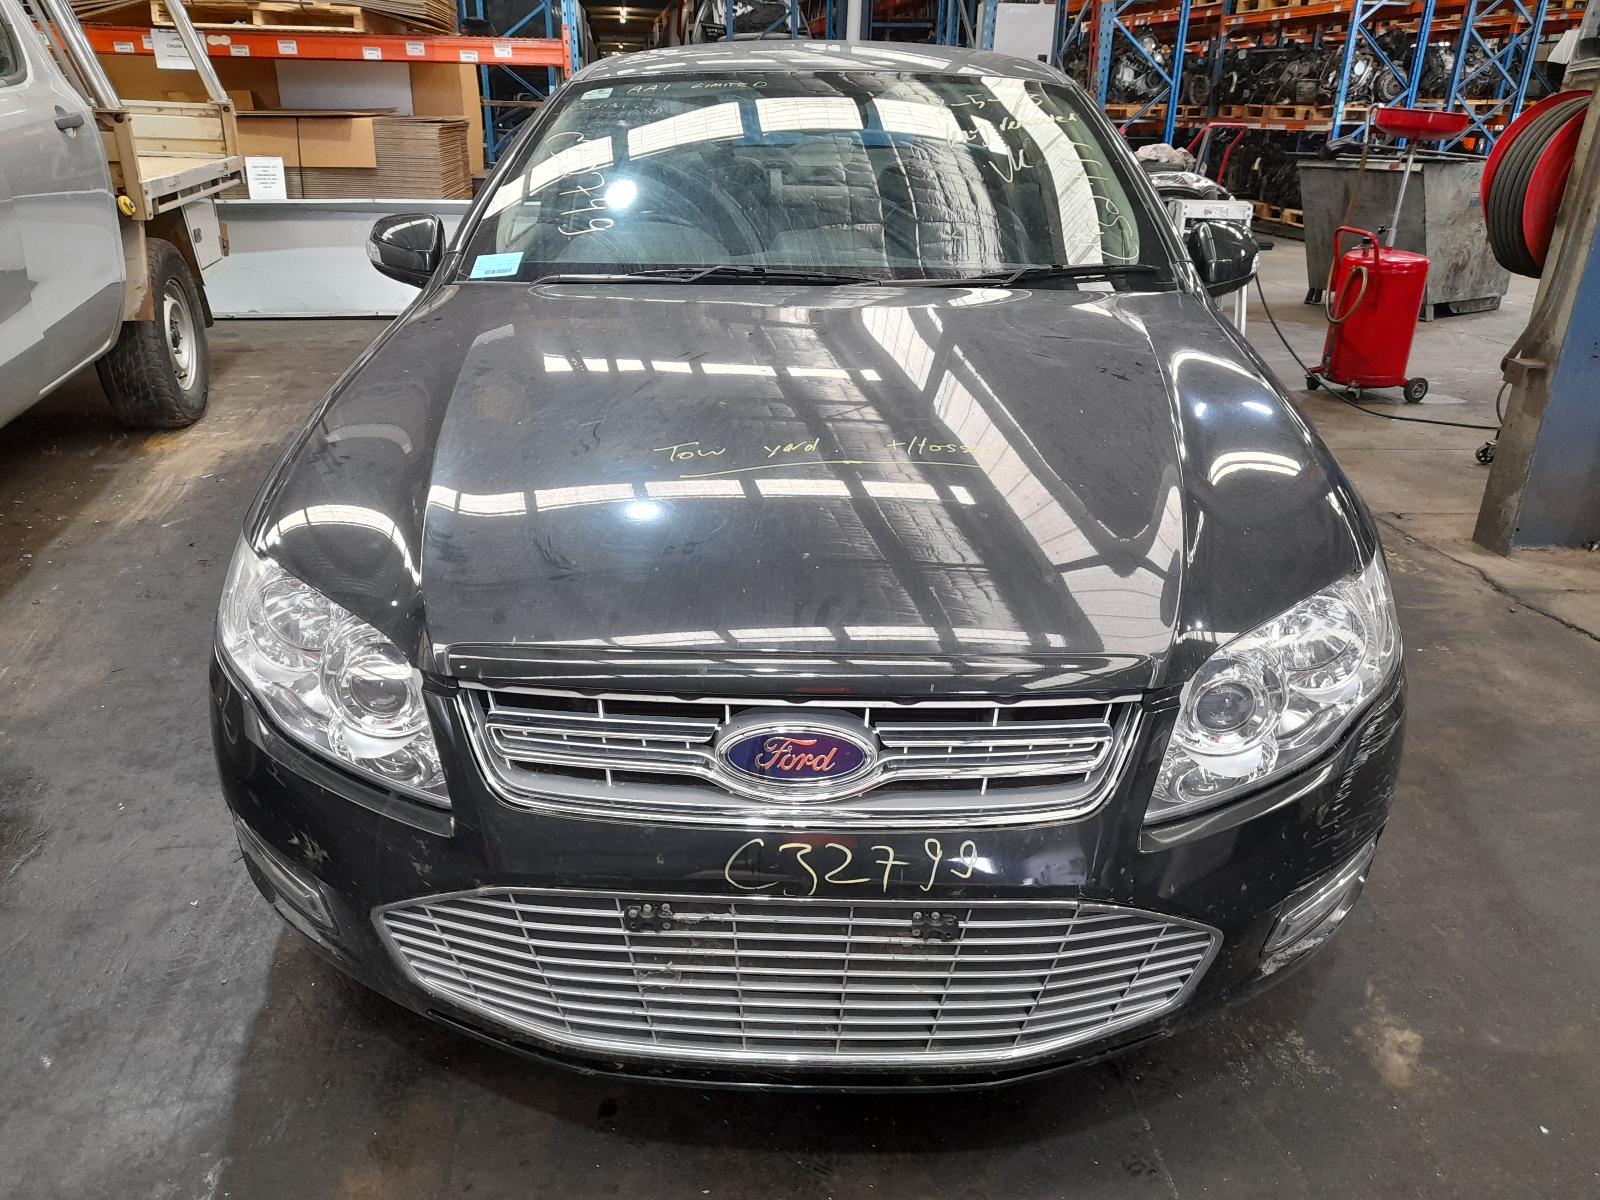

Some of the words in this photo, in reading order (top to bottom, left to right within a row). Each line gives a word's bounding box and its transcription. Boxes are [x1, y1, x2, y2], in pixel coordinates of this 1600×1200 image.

[653, 441, 726, 462] Tow
[754, 736, 838, 772] Ford
[724, 837, 978, 896] C32799
